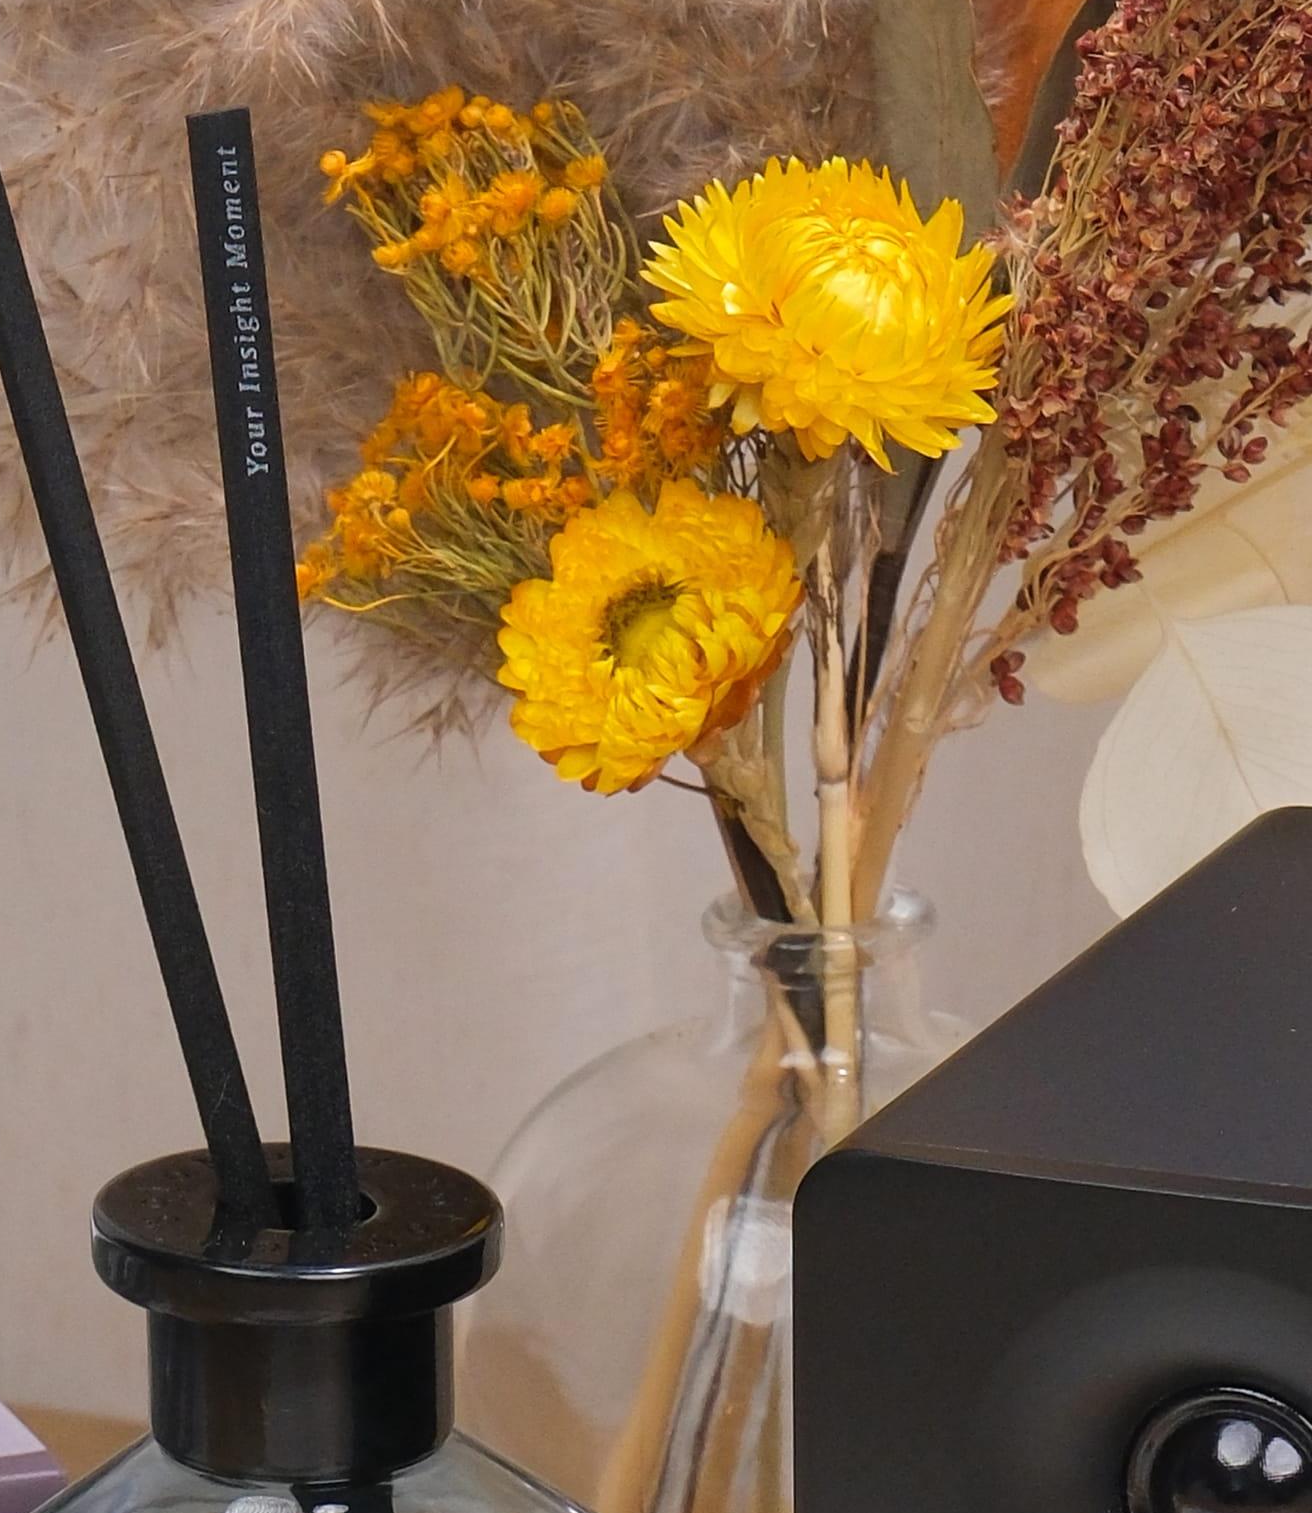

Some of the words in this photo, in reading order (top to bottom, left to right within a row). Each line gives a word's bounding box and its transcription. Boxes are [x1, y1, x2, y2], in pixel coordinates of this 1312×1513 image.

[216, 145, 248, 269] Moment
[229, 282, 261, 393] Insight
[246, 405, 269, 477] Your
